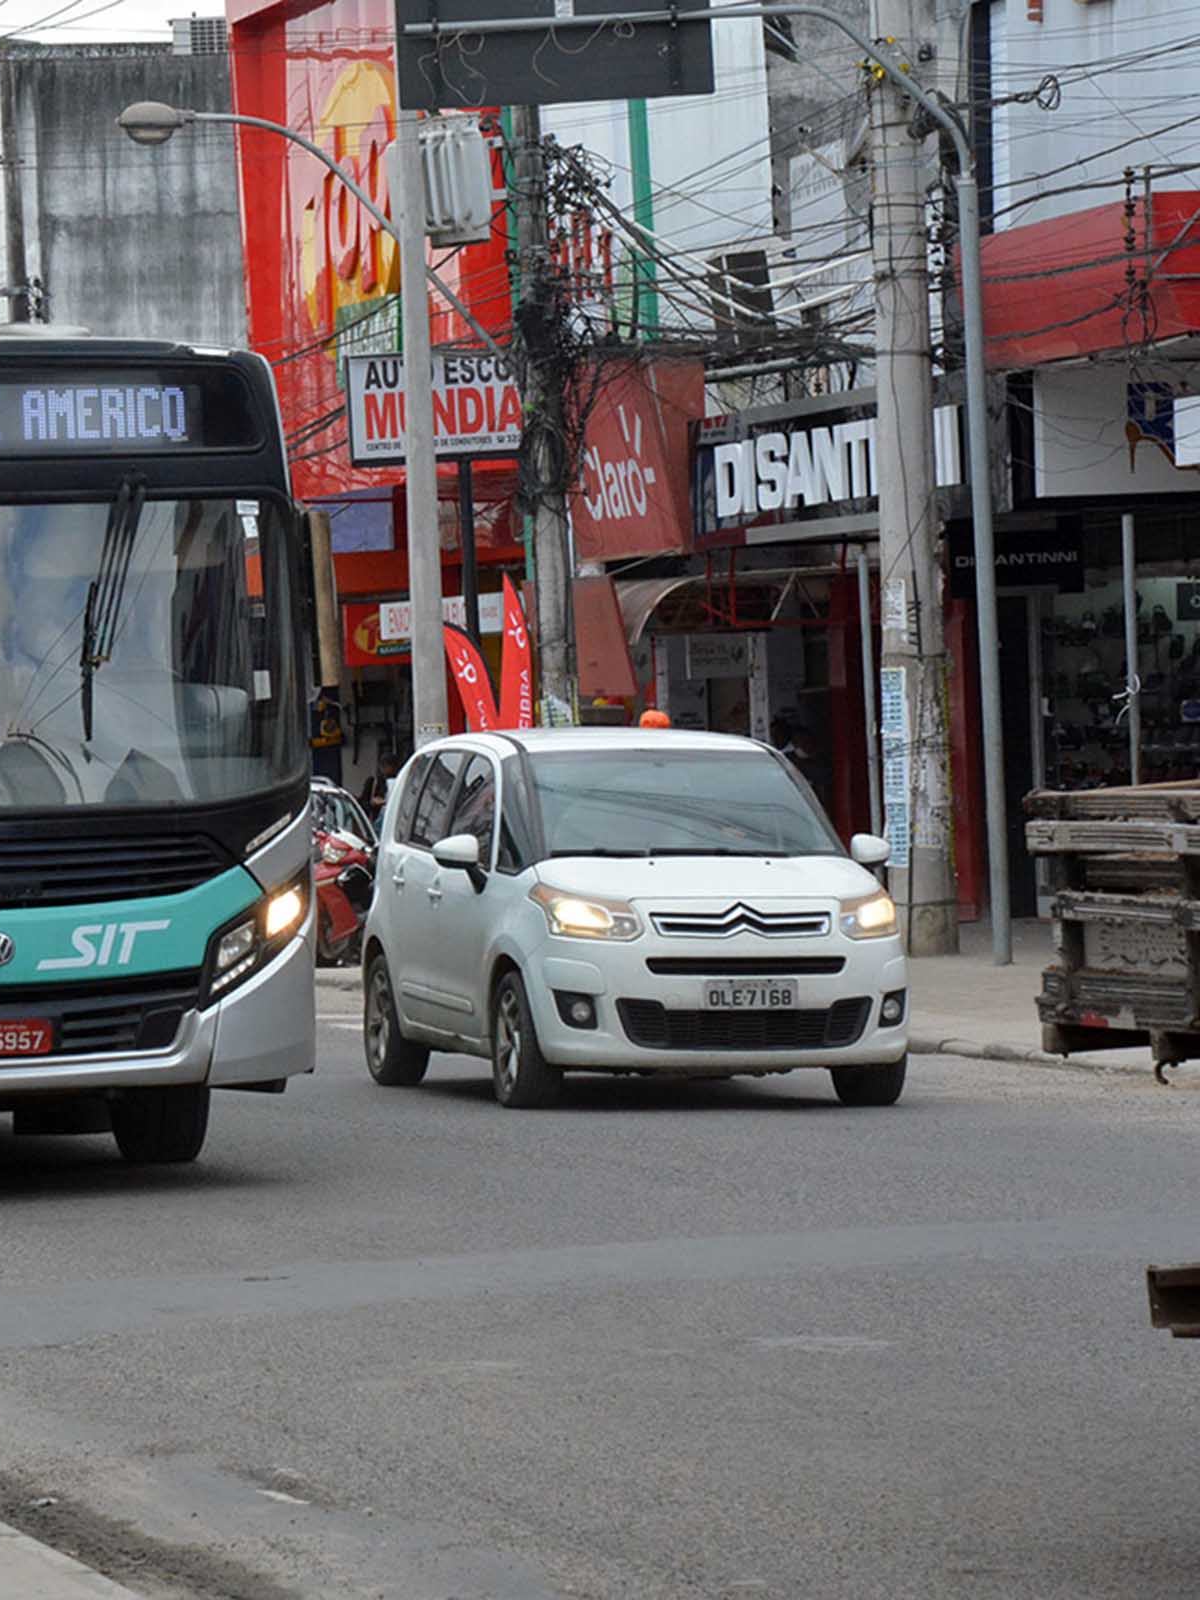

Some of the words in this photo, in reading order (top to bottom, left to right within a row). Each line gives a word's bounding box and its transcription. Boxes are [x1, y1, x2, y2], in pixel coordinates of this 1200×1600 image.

[22, 387, 187, 442] AMERICO
[580, 447, 648, 520] Claro
[36, 919, 172, 971] SIT
